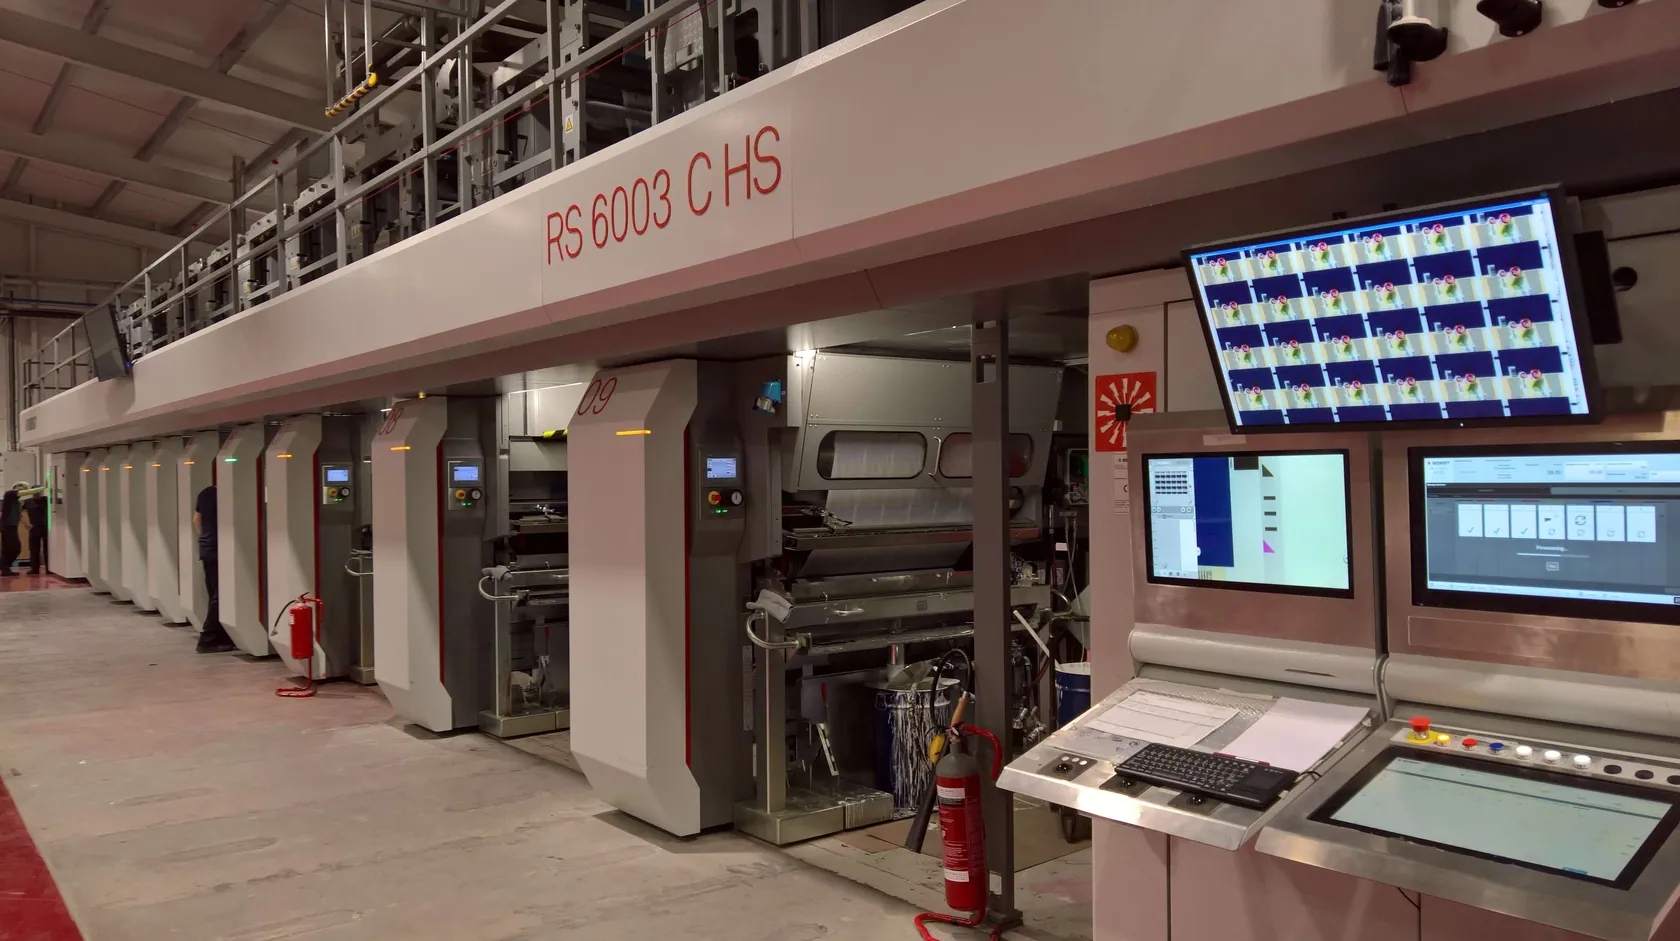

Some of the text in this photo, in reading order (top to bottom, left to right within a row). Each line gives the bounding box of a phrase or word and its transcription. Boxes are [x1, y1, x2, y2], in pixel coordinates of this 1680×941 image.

[547, 125, 782, 265] RS 6003 C HS
[577, 377, 617, 416] 09
[378, 407, 404, 435] 08
